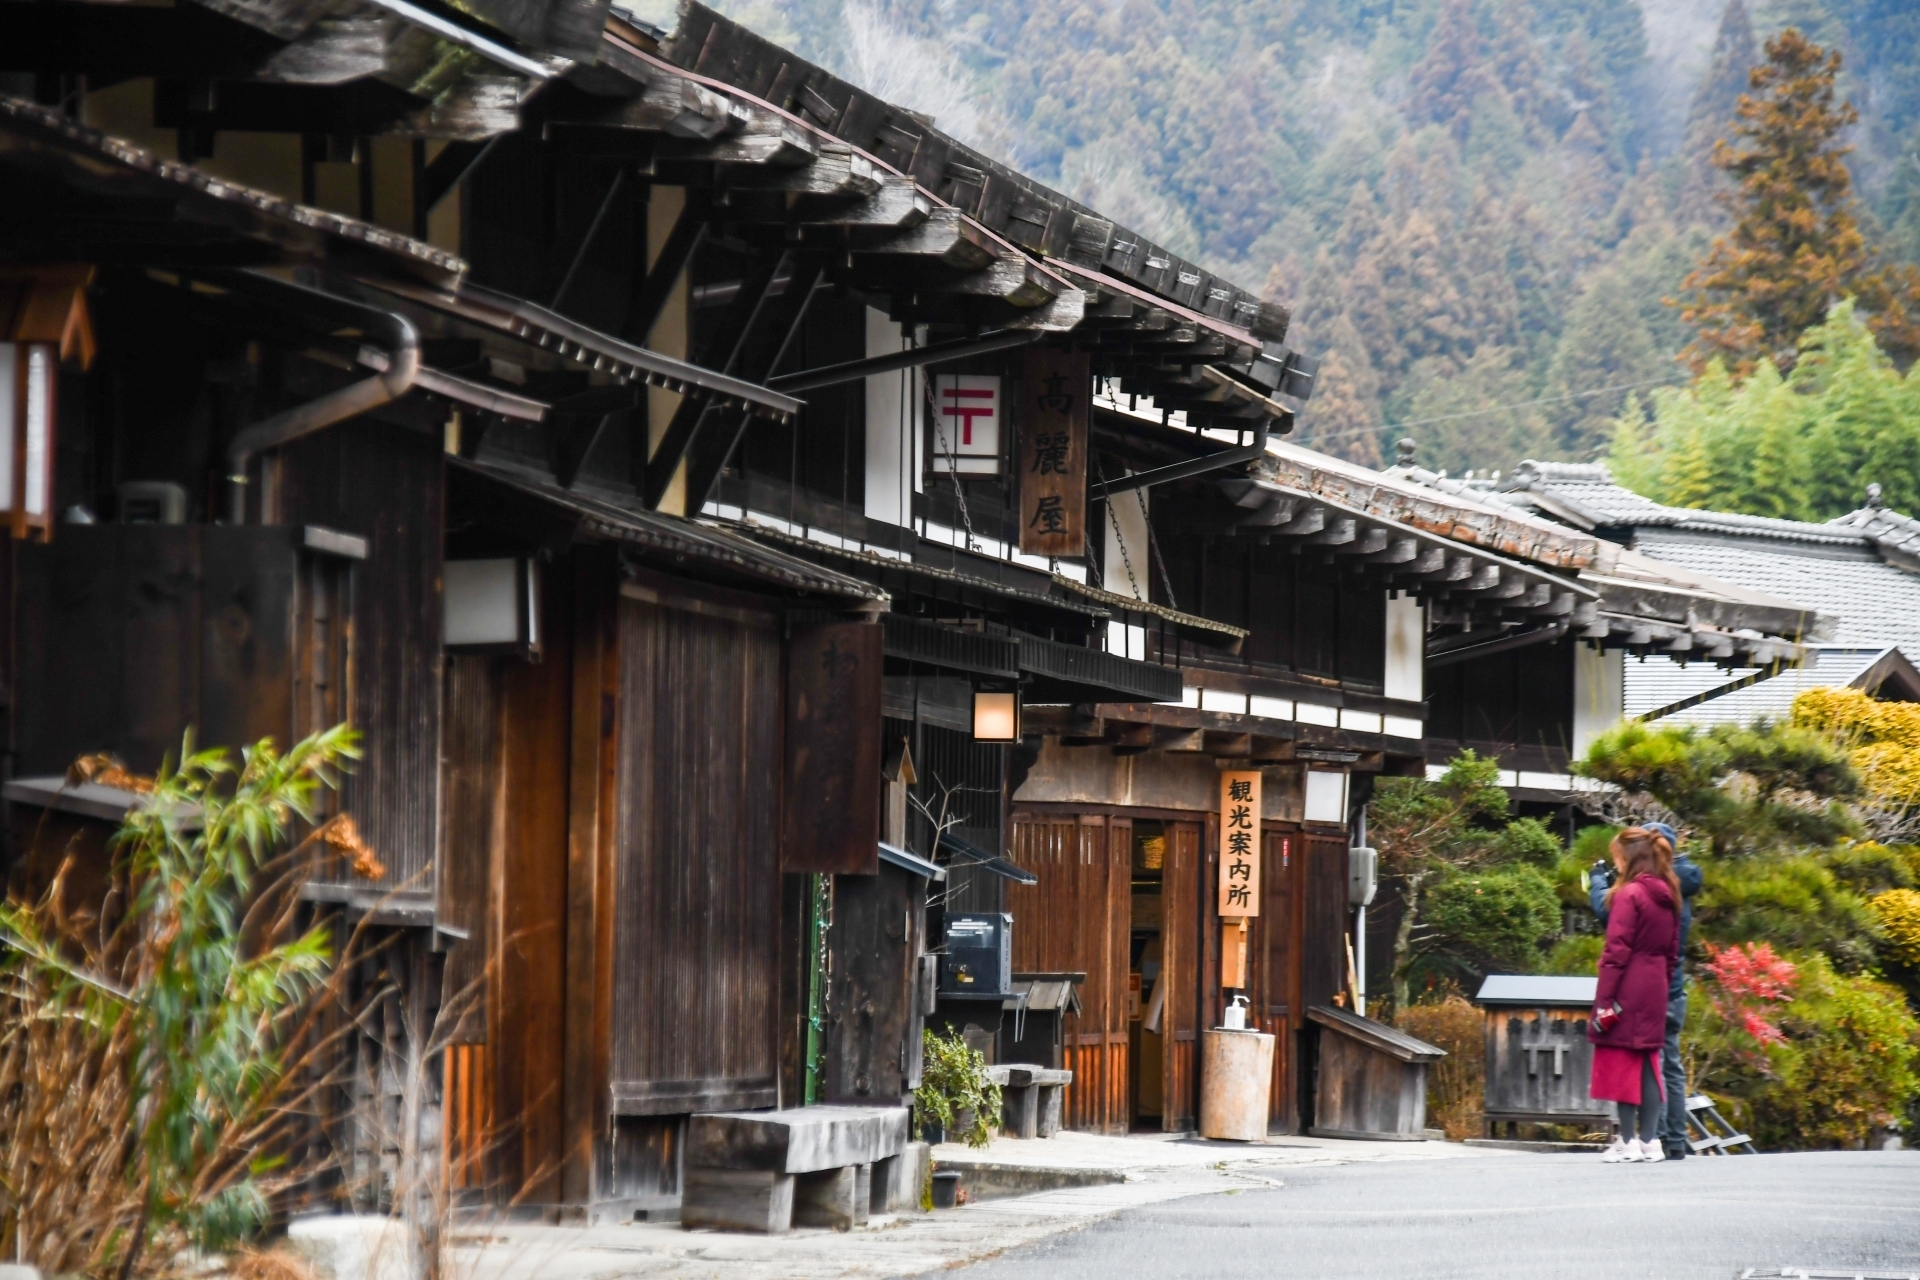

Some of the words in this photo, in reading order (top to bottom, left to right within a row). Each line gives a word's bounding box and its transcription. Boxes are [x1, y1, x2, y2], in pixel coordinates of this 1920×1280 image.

[1227, 779, 1253, 908] 観光案内所
